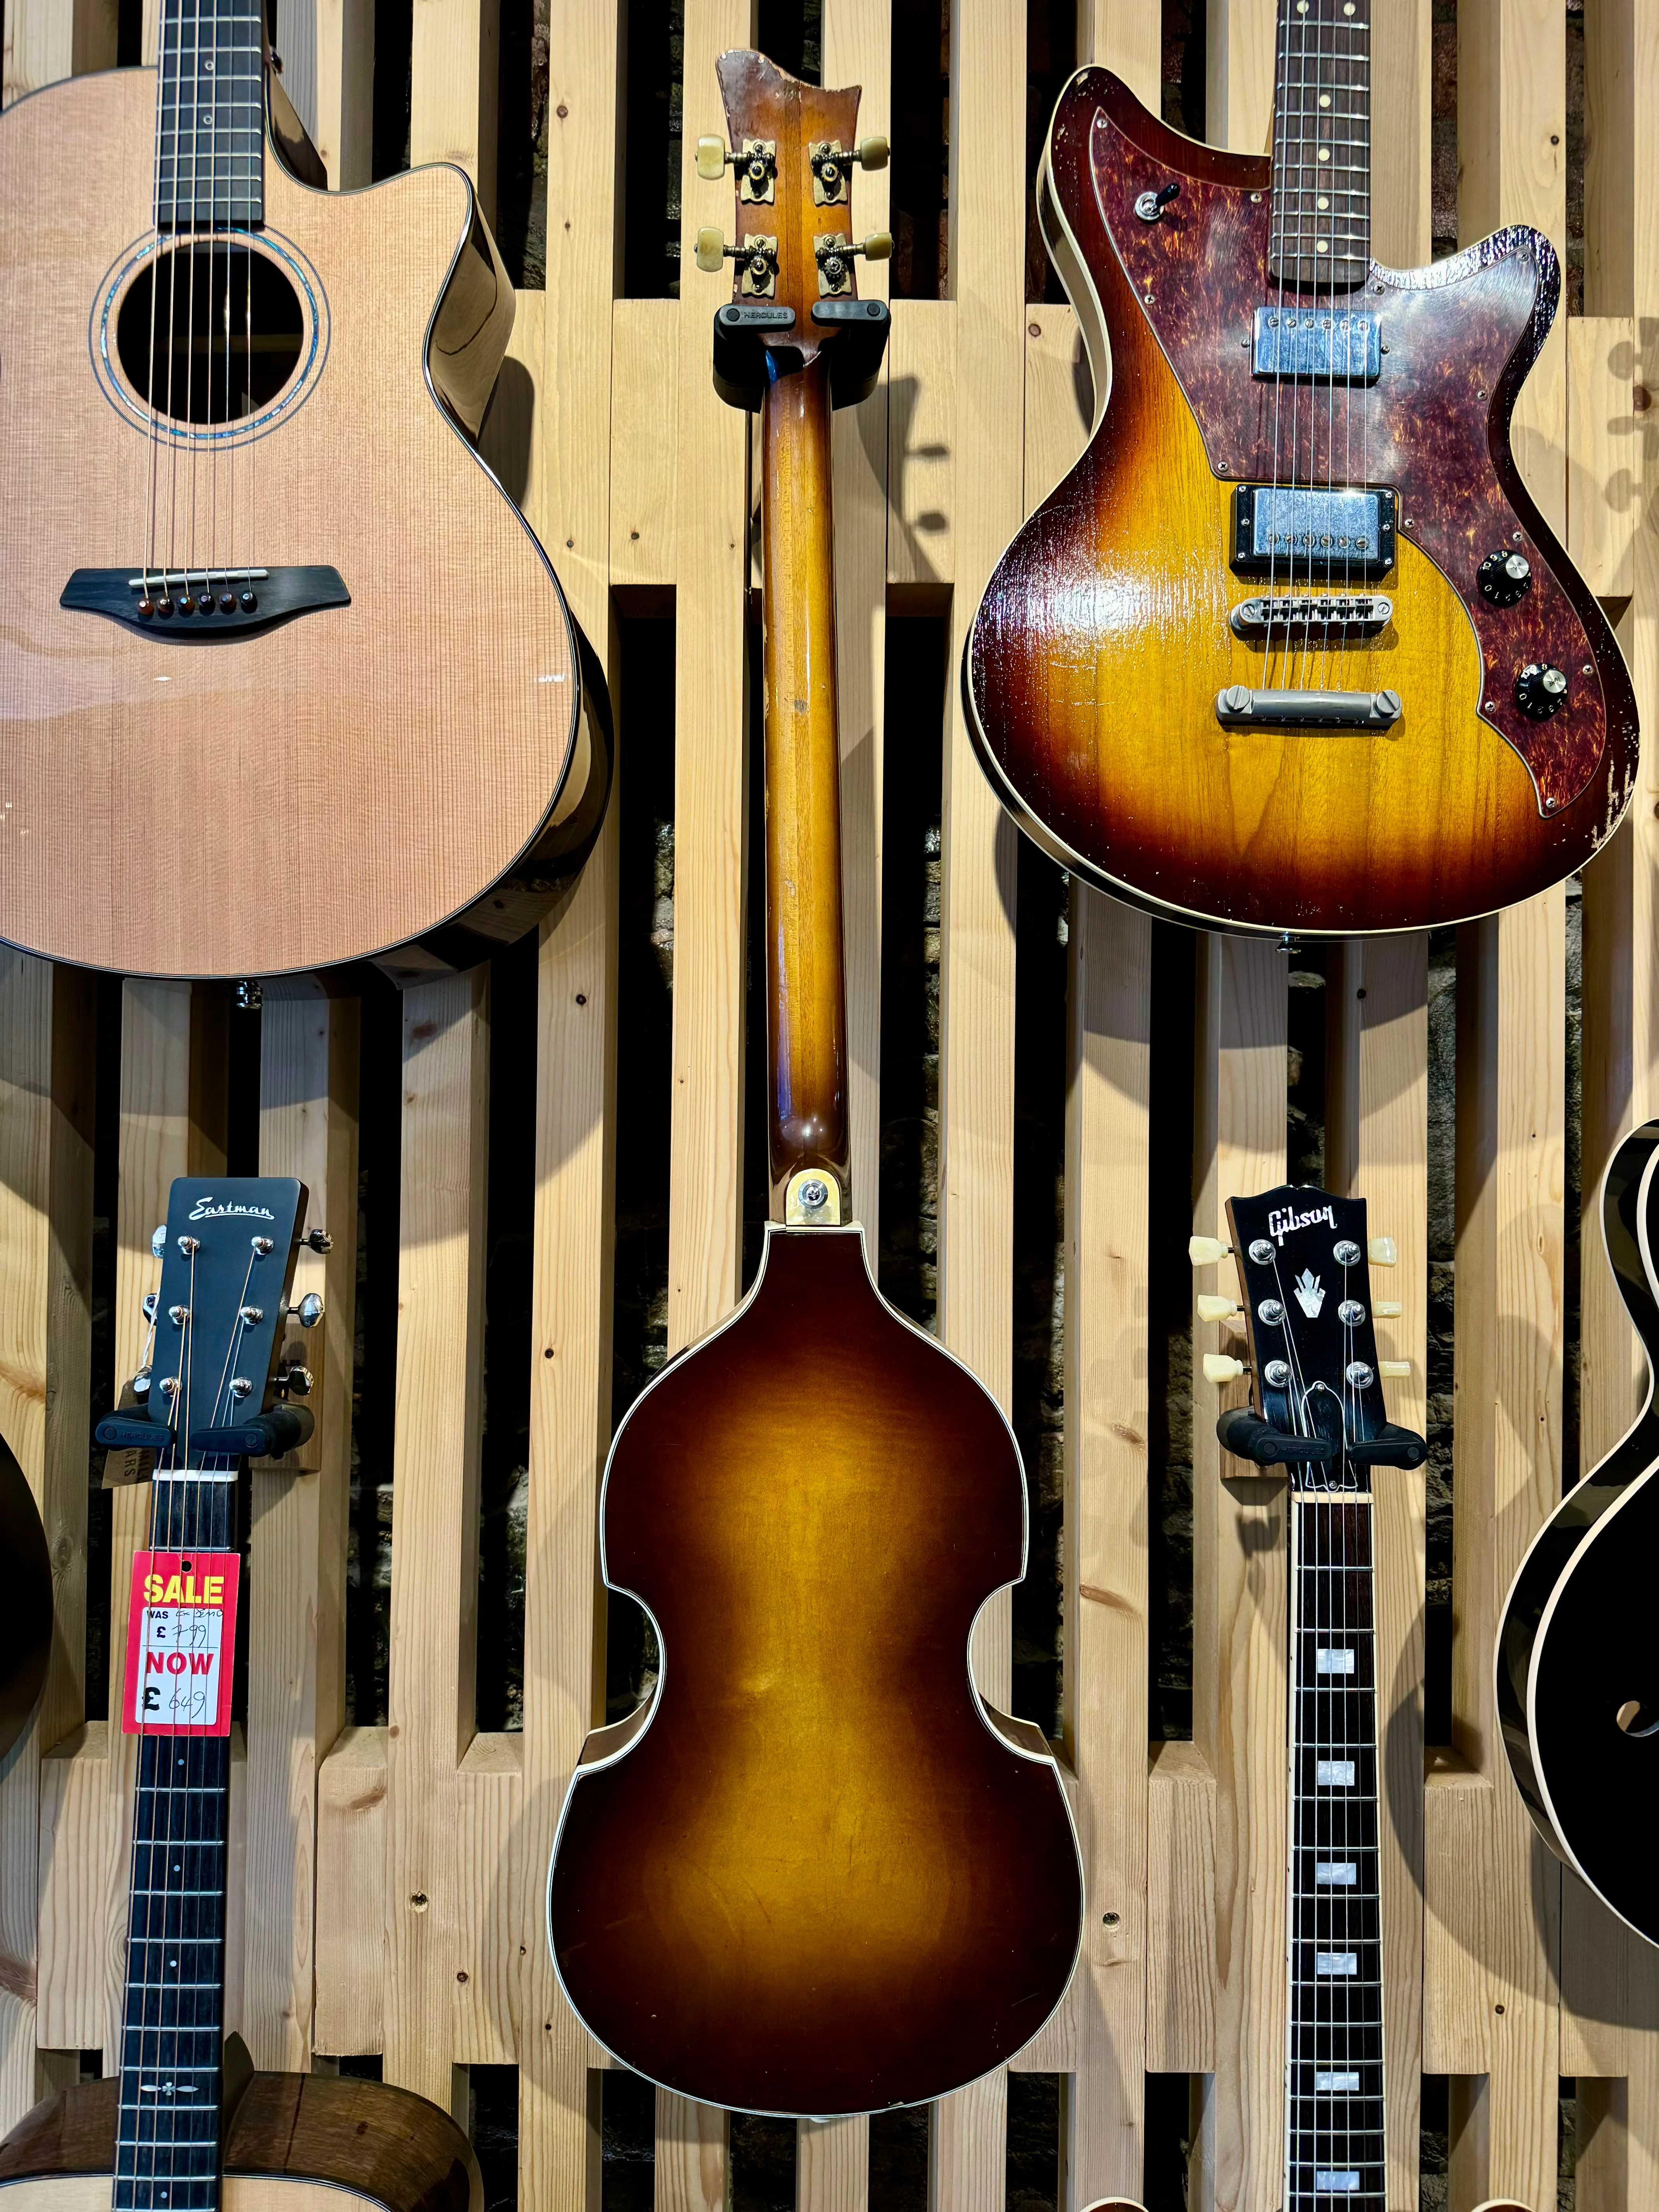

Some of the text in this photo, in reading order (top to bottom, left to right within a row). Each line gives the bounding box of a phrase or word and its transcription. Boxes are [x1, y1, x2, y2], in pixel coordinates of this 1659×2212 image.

[1482, 562, 1491, 570] 10
[1548, 677, 1562, 687] TONE
[189, 1197, 275, 1220] Eastman
[1268, 1206, 1338, 1246] Gibson
[120, 1432, 165, 1441] HERCULES
[137, 1450, 150, 1484] MILL
[144, 1574, 224, 1604] SALE
[147, 1610, 168, 1619] WAS
[146, 1652, 215, 1675] NOW
